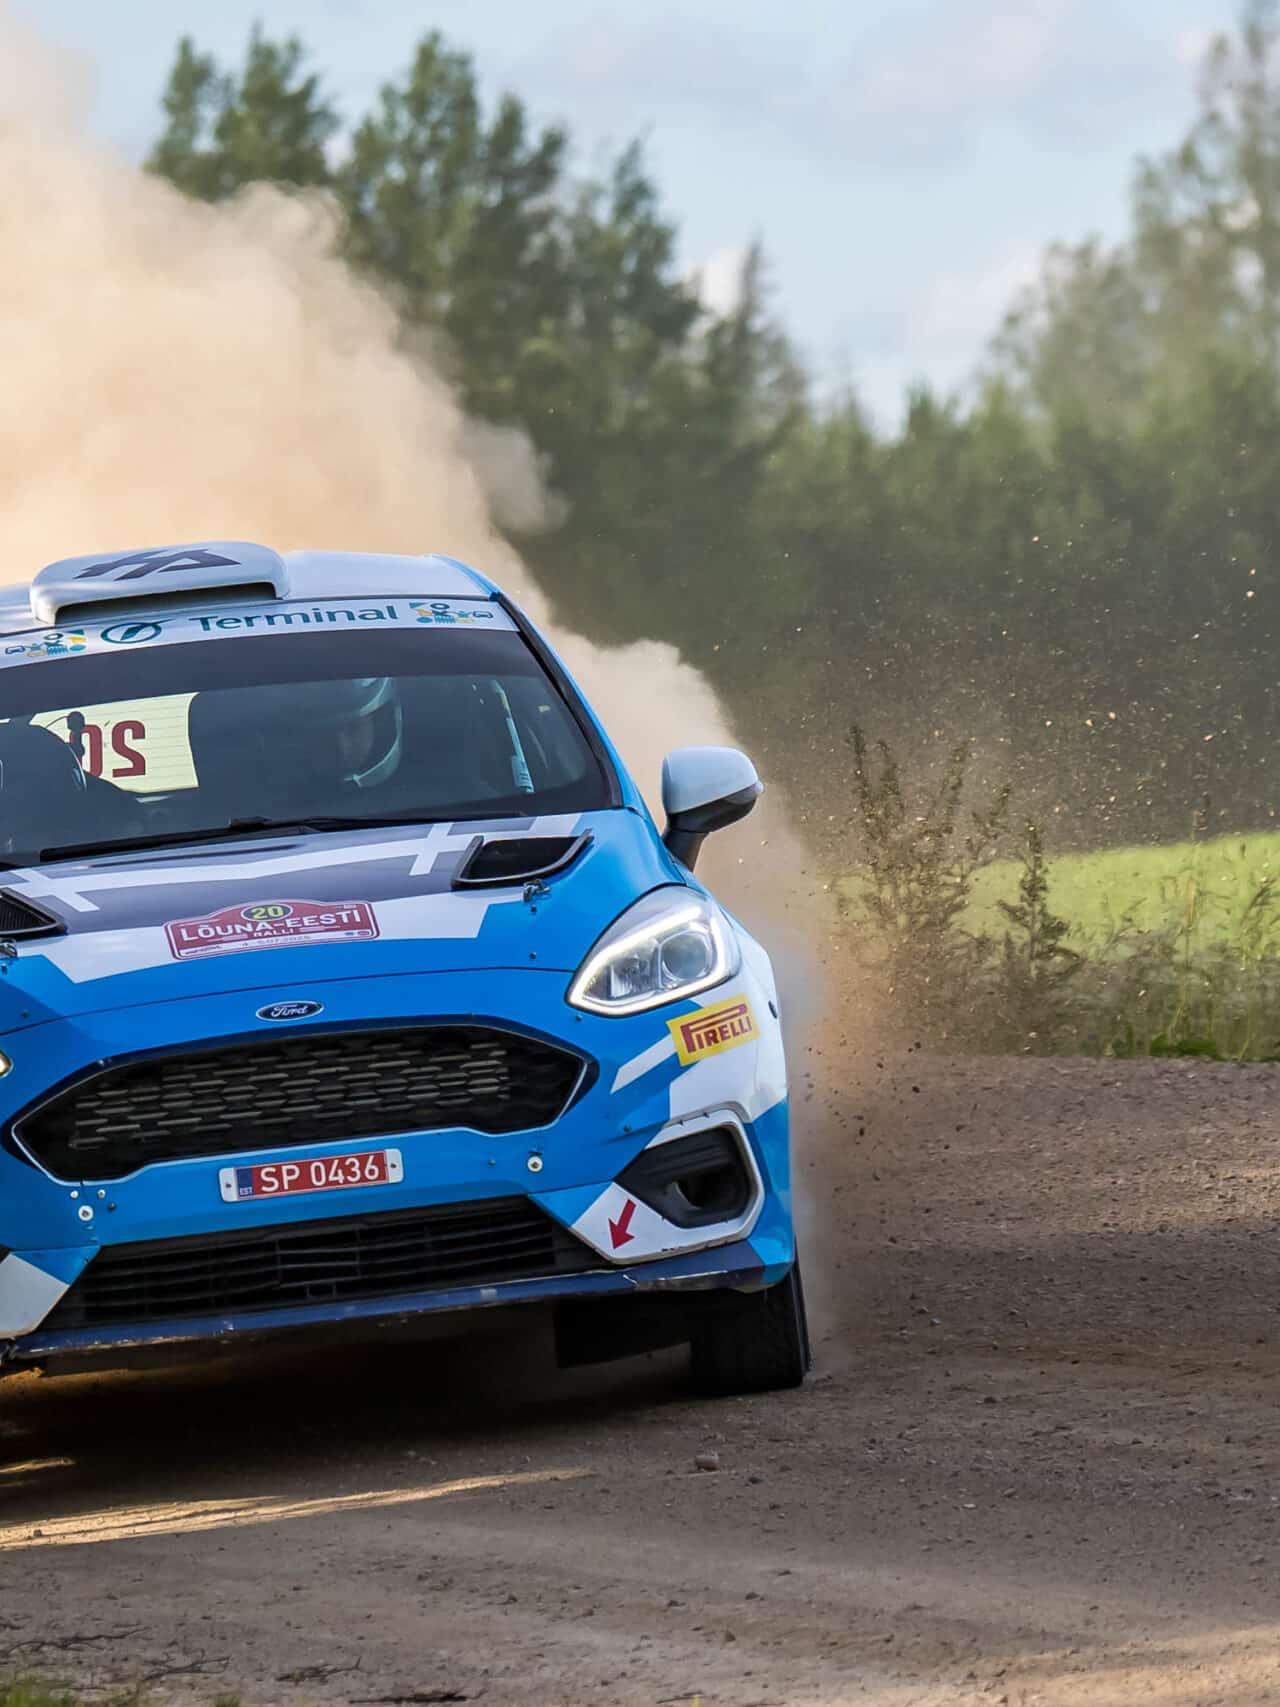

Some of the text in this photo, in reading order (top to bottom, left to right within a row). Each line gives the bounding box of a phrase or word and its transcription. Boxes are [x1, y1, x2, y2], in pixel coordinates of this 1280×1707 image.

[189, 605, 399, 632] Terminal
[180, 909, 361, 942] LÕUNA-EESTI
[251, 905, 284, 920] 20
[271, 1003, 309, 1018] Ford
[680, 1003, 753, 1053] PIRELLI
[260, 1155, 380, 1193] SP 0436
